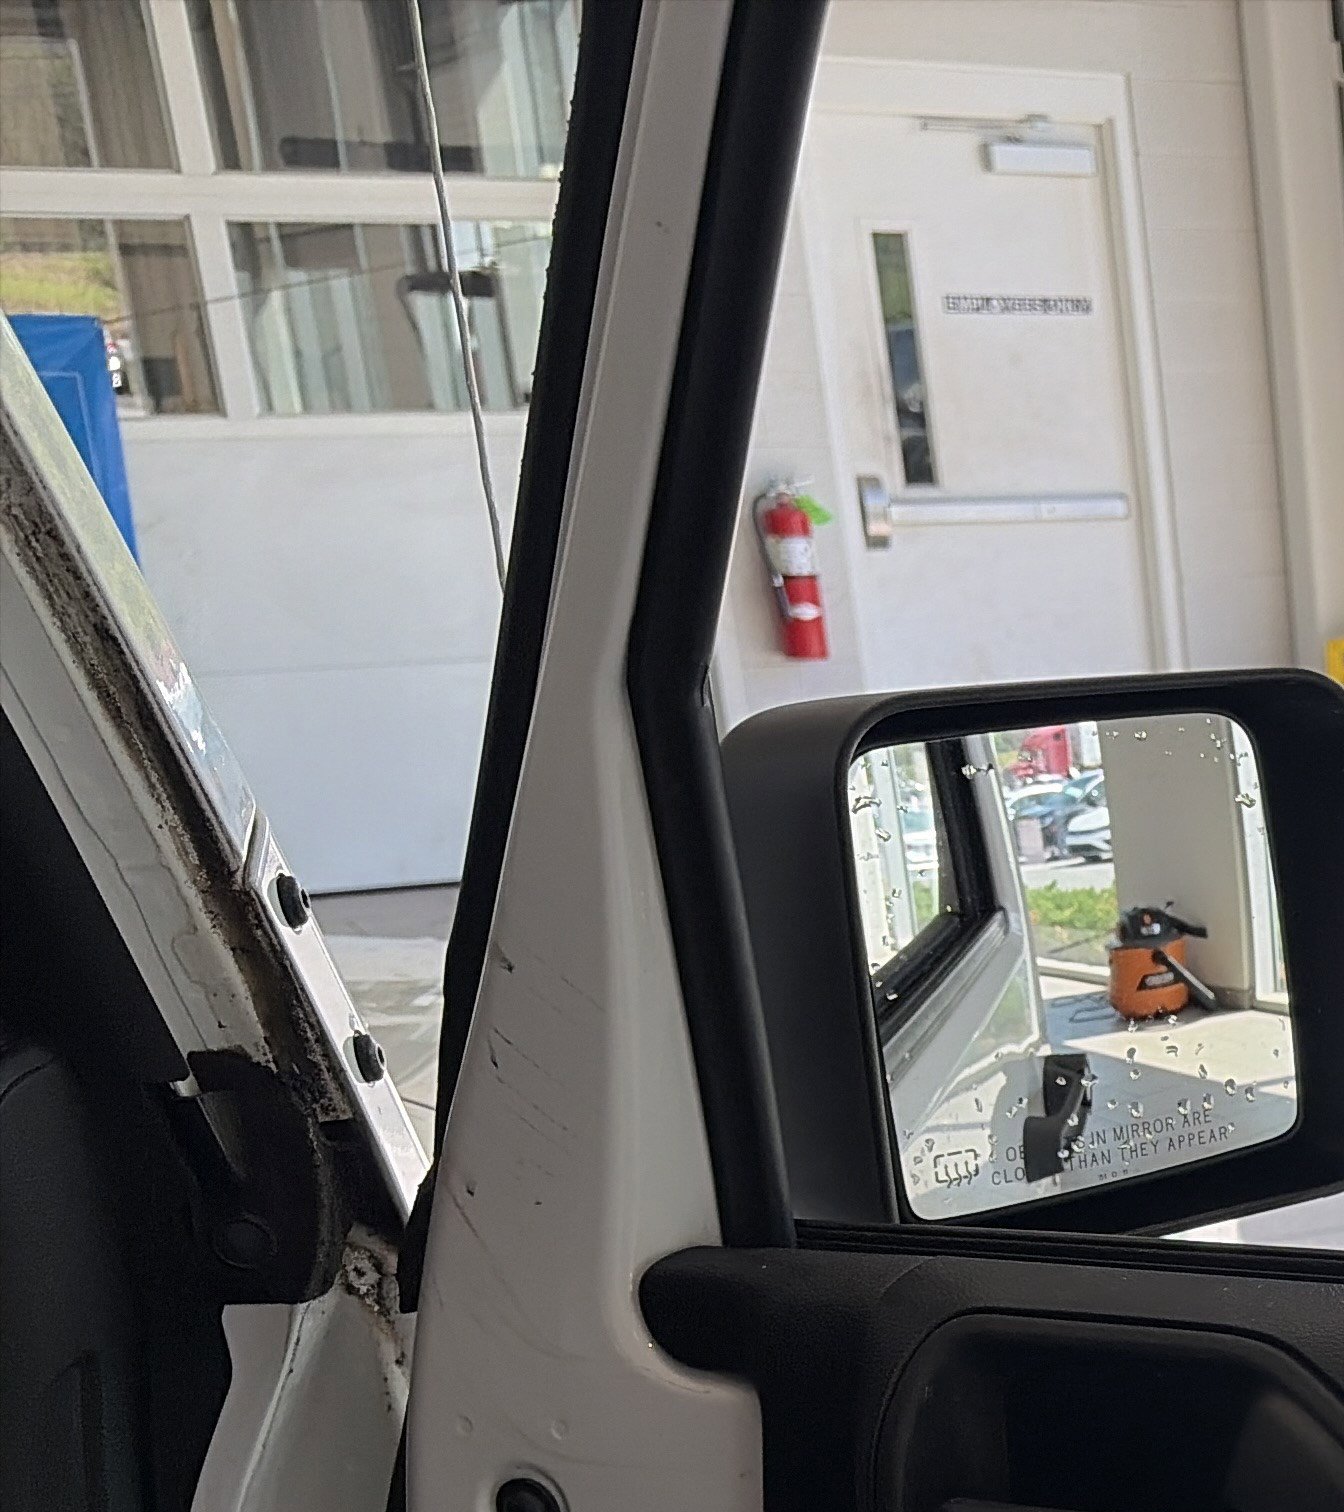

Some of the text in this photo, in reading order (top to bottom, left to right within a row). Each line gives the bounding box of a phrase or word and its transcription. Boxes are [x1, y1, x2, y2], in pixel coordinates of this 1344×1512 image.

[1091, 1129, 1106, 1146] IN
[1113, 1116, 1174, 1141] MIRROR
[1182, 1109, 1212, 1128] ARE
[1067, 1149, 1112, 1171] THAN
[1118, 1140, 1159, 1161] THEY
[1168, 1126, 1229, 1152] APPEAR
